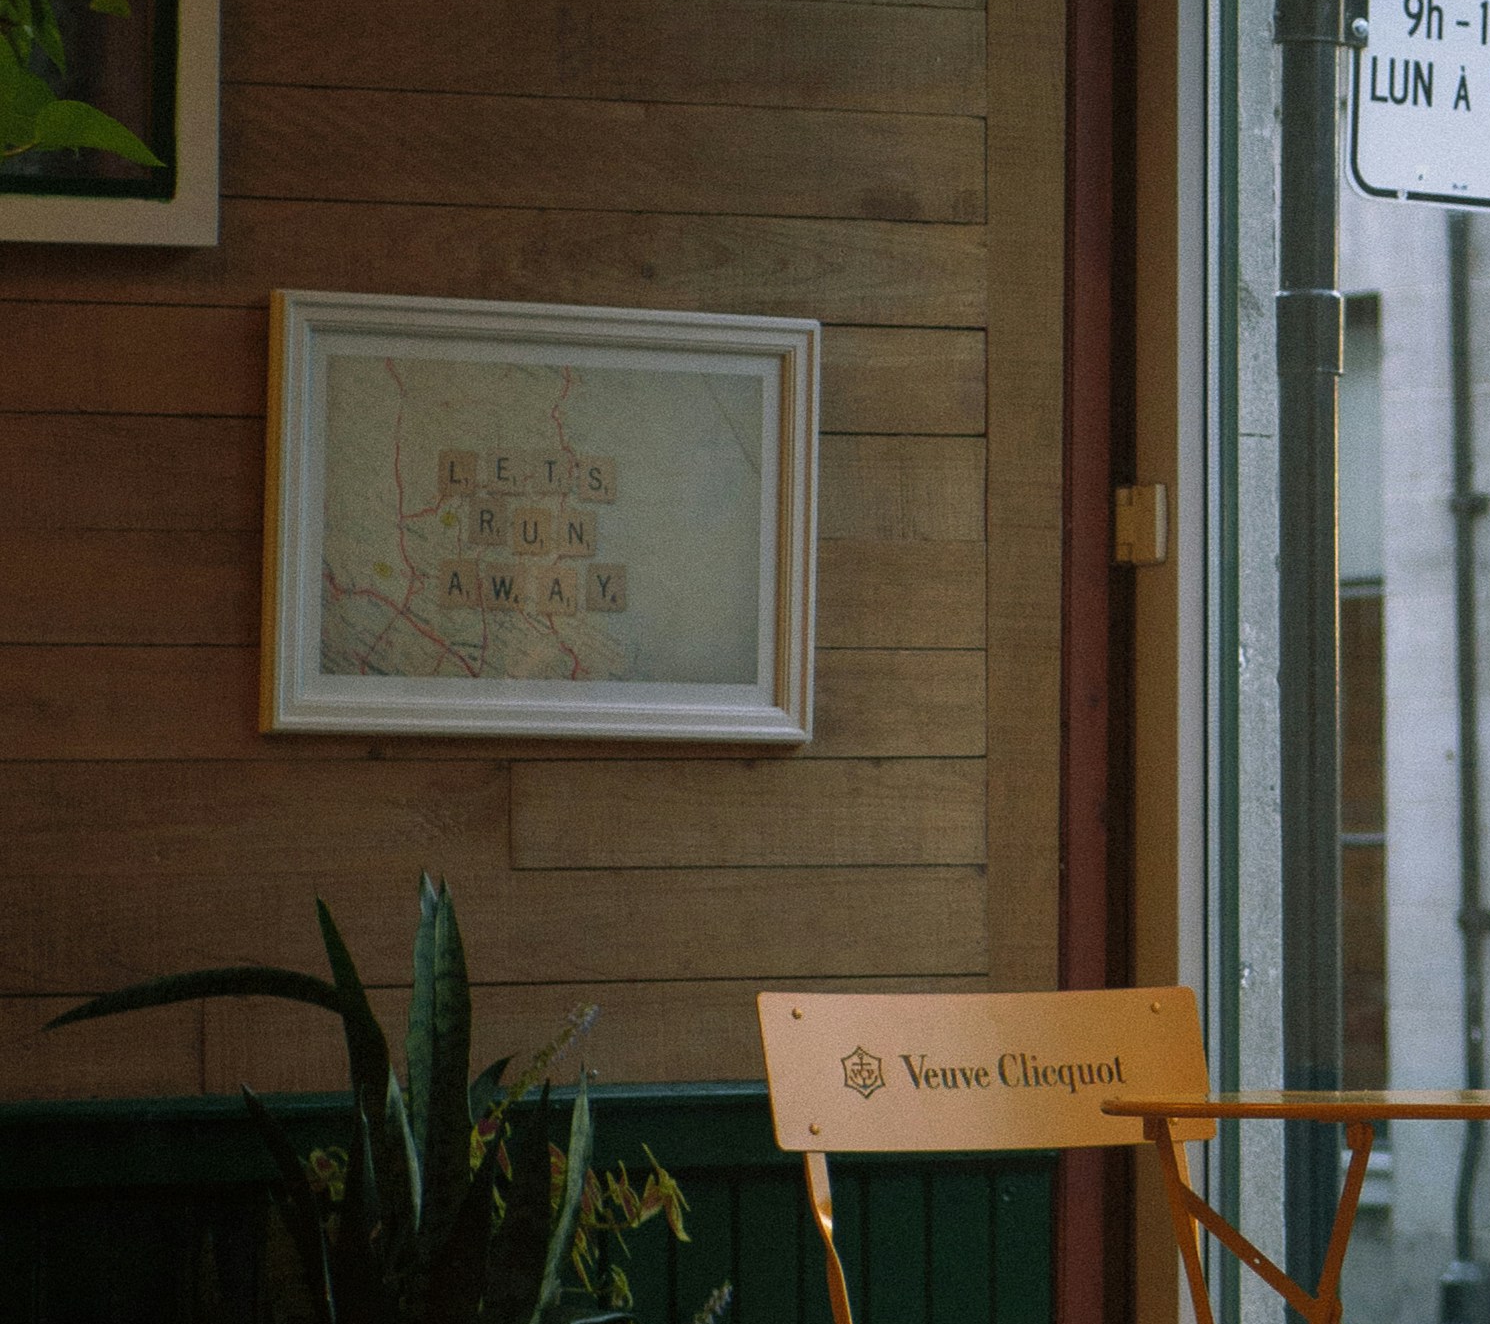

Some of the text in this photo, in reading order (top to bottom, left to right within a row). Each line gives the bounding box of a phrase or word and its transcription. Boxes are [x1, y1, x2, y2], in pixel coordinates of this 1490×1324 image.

[1371, 55, 1433, 107] LUN
[1453, 65, 1471, 111] À
[479, 509, 593, 550] RUN
[447, 571, 617, 609] AWAY
[900, 1052, 1126, 1093] Veuve Clicquot
